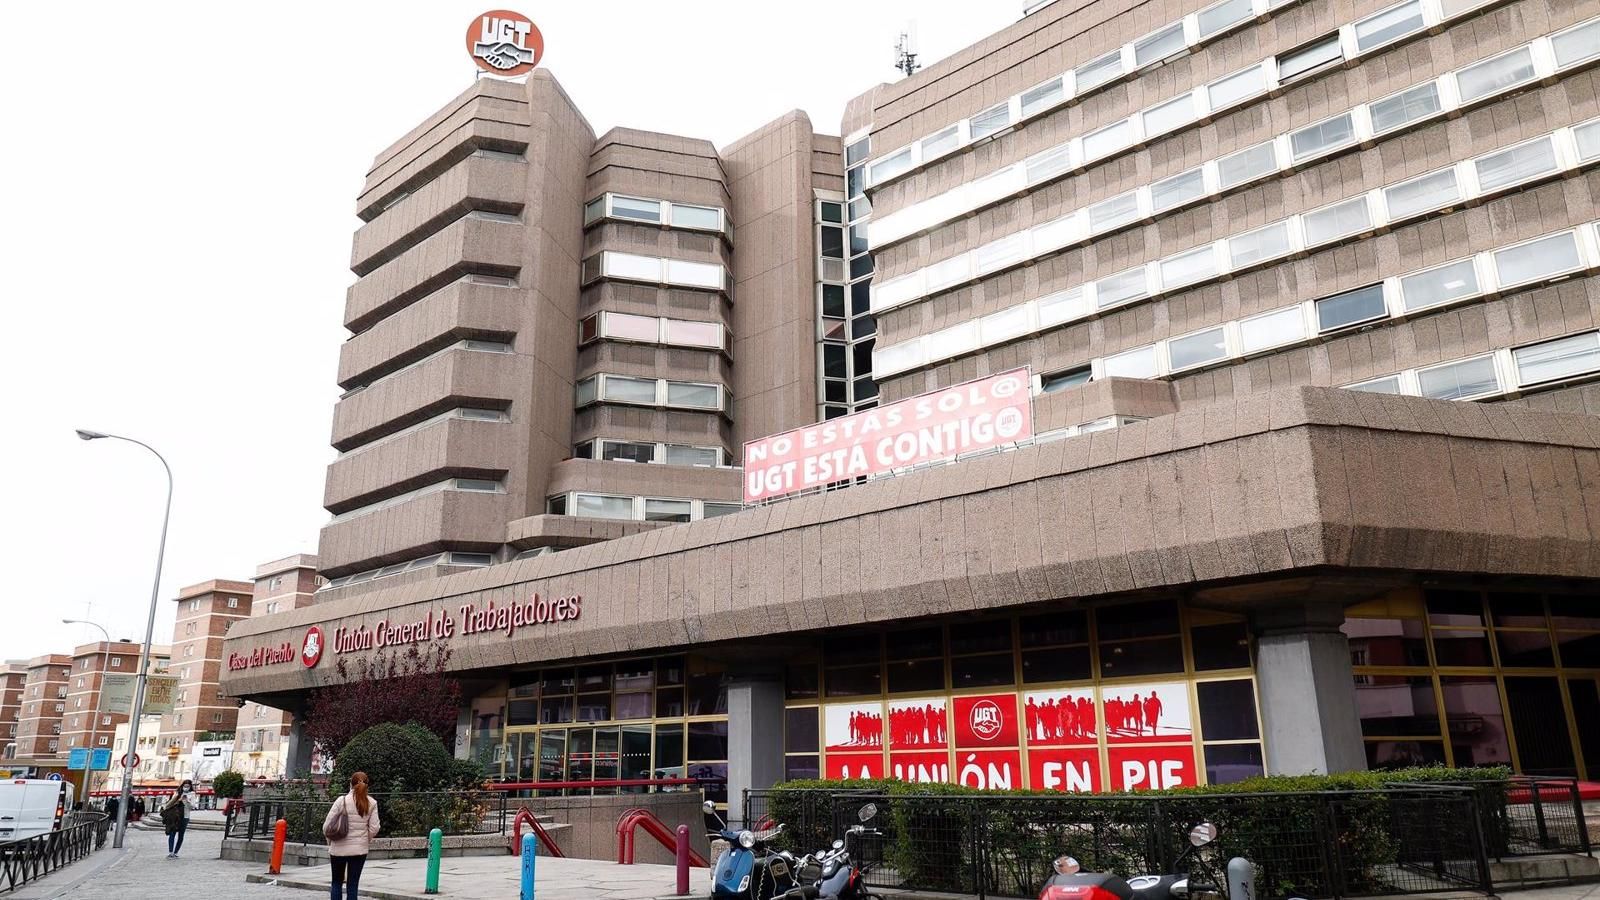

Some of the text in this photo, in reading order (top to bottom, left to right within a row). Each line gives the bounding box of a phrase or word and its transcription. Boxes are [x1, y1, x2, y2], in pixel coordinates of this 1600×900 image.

[481, 16, 531, 48] UGT
[749, 438, 791, 463] NO
[748, 462, 796, 497] UGT
[803, 438, 869, 484] ESTÁ
[333, 593, 582, 654] Unión General de Trabajadores
[228, 641, 296, 672] Casa del Pueblo
[974, 707, 997, 722] UGT
[1043, 760, 1092, 793] EN
[1122, 759, 1184, 793] PIE
